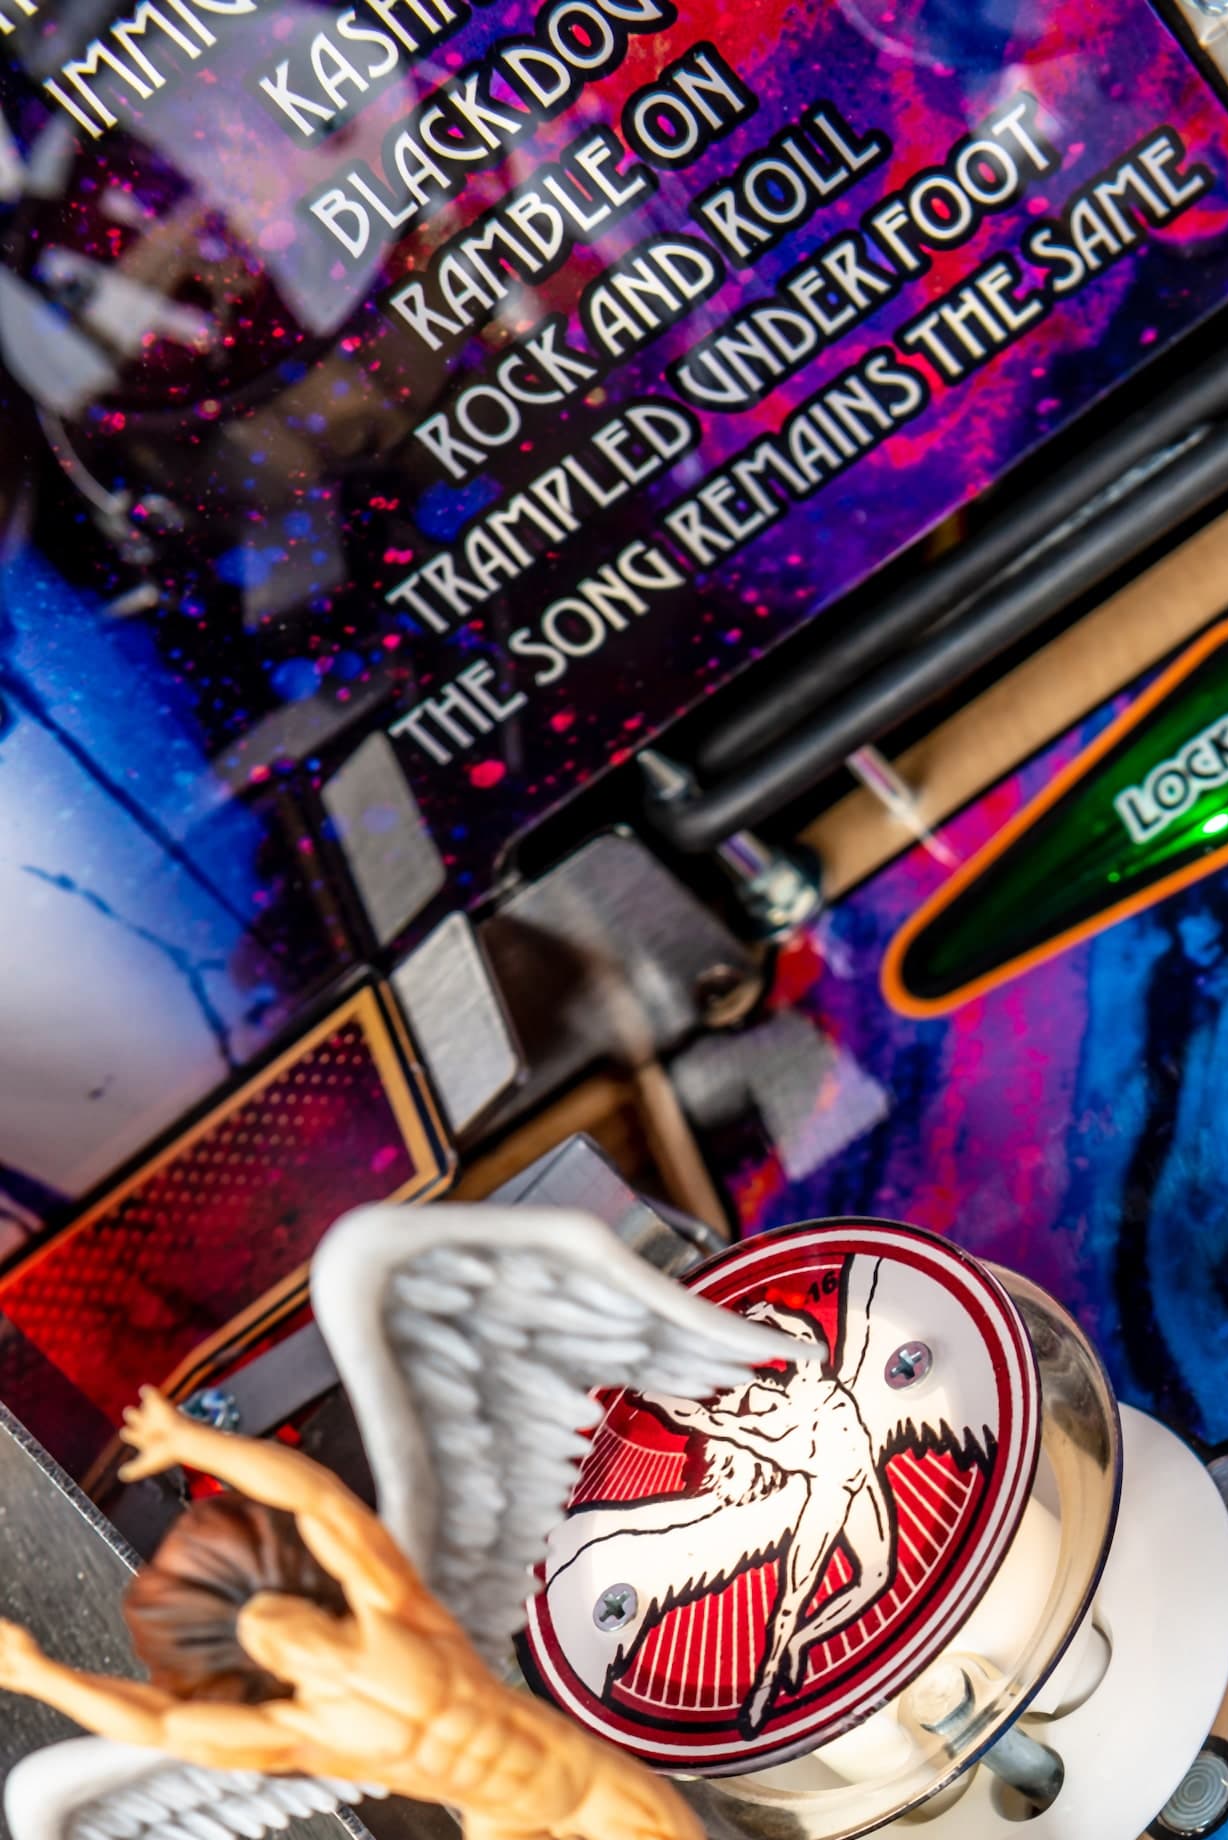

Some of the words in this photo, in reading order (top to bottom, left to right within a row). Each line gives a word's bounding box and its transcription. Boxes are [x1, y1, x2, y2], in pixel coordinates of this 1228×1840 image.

[310, 72, 522, 259] BLACK
[390, 137, 646, 350] RAMBLE
[633, 53, 746, 160] ON
[414, 331, 596, 480] ROCK
[590, 243, 717, 357] AND
[703, 112, 881, 259] ROLL
[385, 404, 693, 634] TRAMPLED
[389, 660, 527, 765] THE
[509, 541, 685, 686] SONG
[665, 354, 923, 565] REMAINS
[904, 262, 1042, 378] THE
[1030, 138, 1205, 293] SAME
